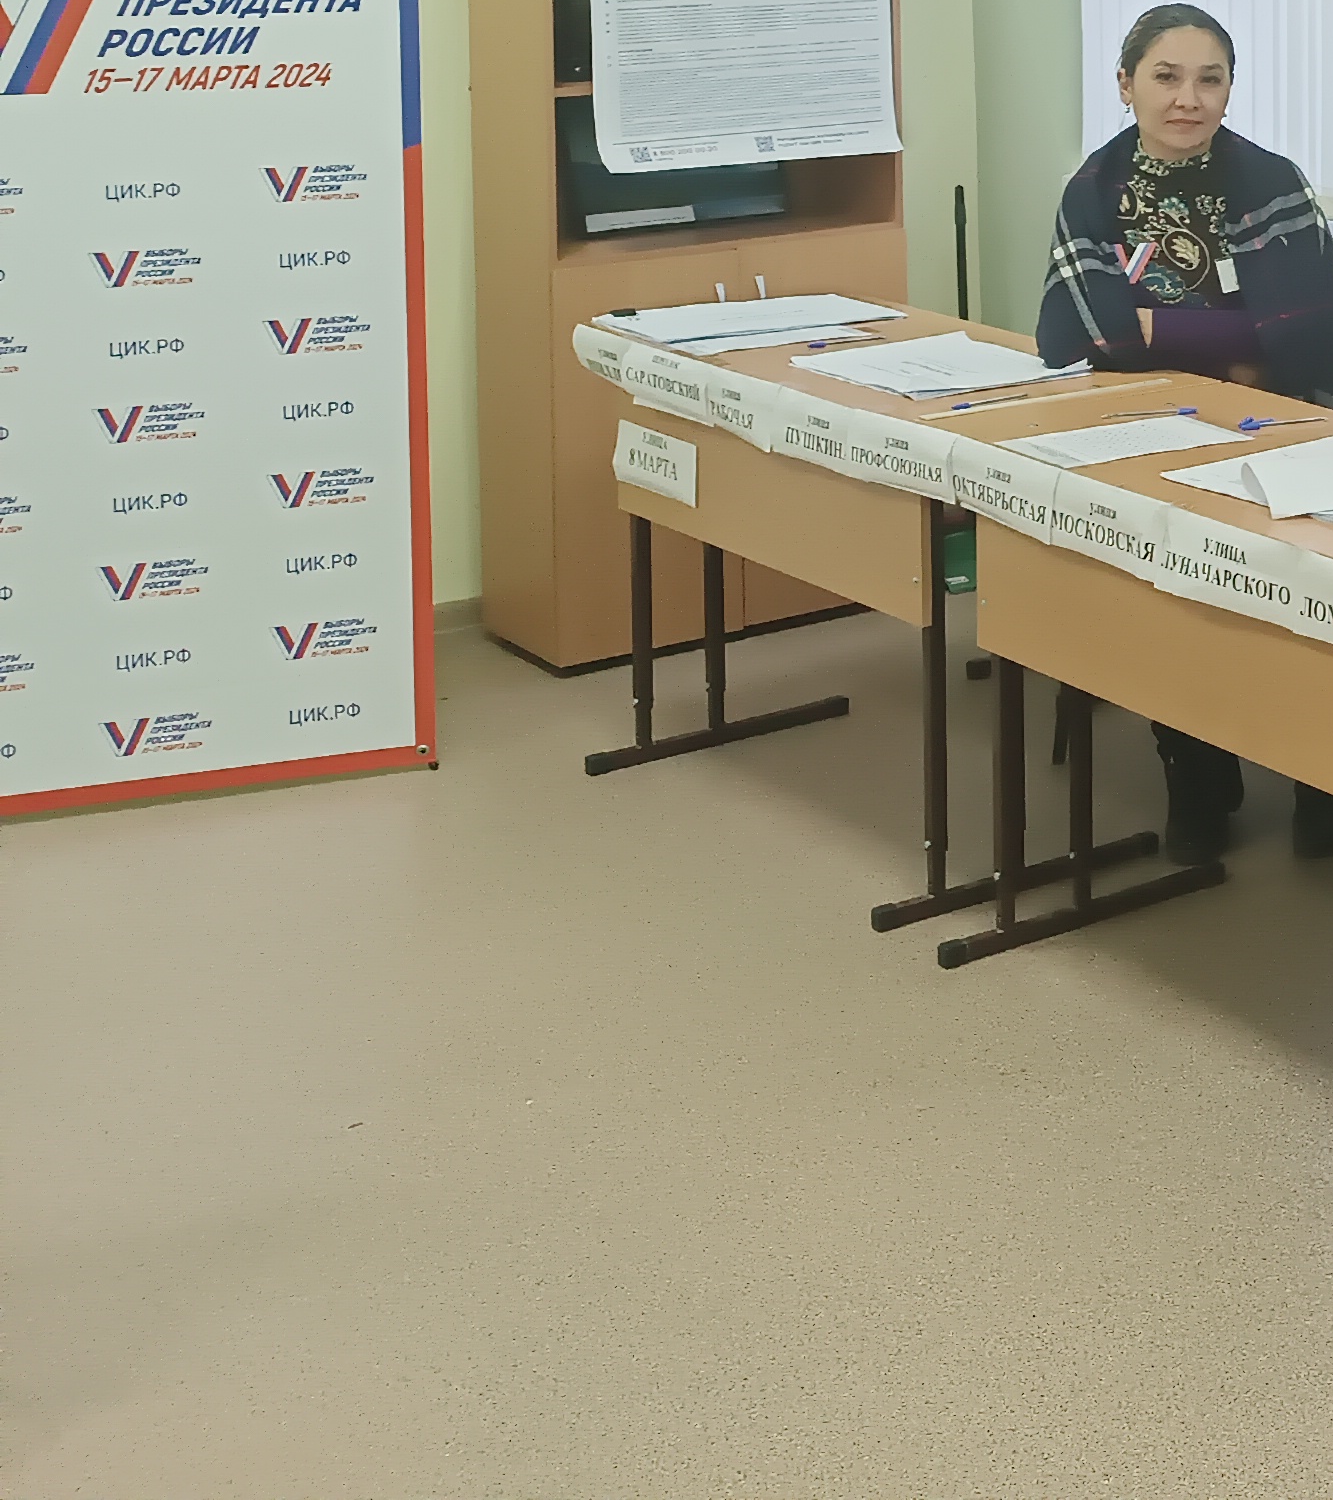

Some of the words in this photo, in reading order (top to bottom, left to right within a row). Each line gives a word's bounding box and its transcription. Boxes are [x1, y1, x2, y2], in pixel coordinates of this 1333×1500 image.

[97, 27, 260, 58] РОССИИ
[165, 65, 262, 92] МАРТА
[265, 62, 333, 89] 2024
[106, 183, 180, 202] ЦИК.РФ
[280, 250, 351, 270] ЦИК.РФ
[110, 338, 184, 359] ЦИК.РФ
[626, 367, 700, 401] САРАТОВСКИЙ
[283, 401, 354, 421] ЦИК.РФ
[709, 400, 754, 429] РАБОЧАЯ
[785, 426, 846, 460] ПУШКИН
[637, 450, 678, 481] МАРТА
[851, 446, 943, 483] ПРОФСОЮЗНАЯ
[113, 492, 187, 515] ЦИК.РФ
[952, 474, 1047, 525] ОКТЯБРЬСКАЯ
[1051, 509, 1156, 563] МОСКОВСКАЯ
[287, 553, 357, 575] ЦИК.РФ
[1203, 537, 1247, 565] УЛИЦА
[1160, 550, 1292, 605] ЛУНАЧАРСКОГО
[117, 649, 191, 672] ЦИК.РФ
[289, 703, 360, 727] ЦИК.РФ
